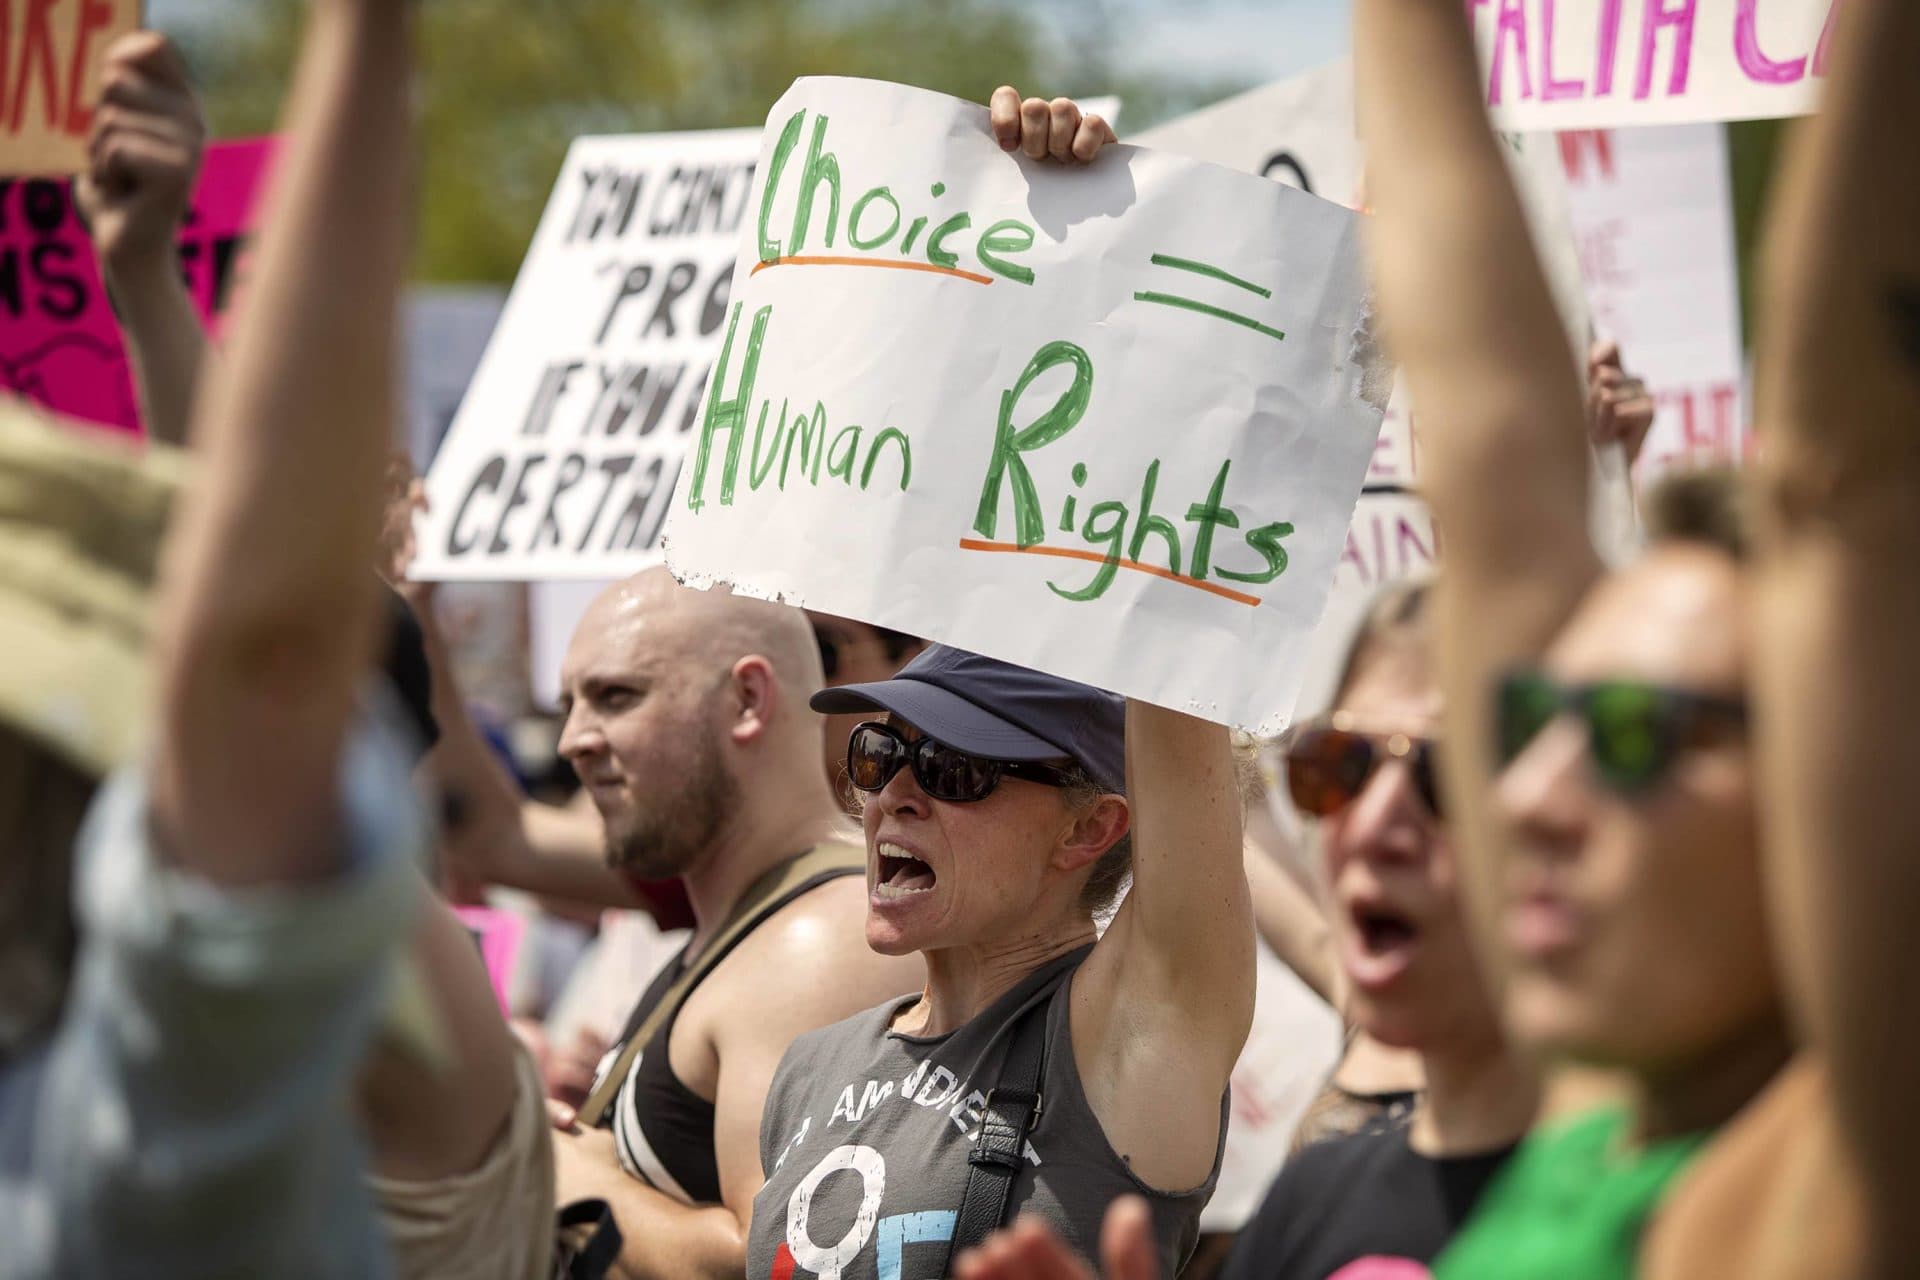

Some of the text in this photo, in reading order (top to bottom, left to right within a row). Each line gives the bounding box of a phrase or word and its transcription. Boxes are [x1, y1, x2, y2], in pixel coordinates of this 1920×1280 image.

[758, 108, 1036, 286] Choice
[688, 300, 1295, 602] Human Rights
